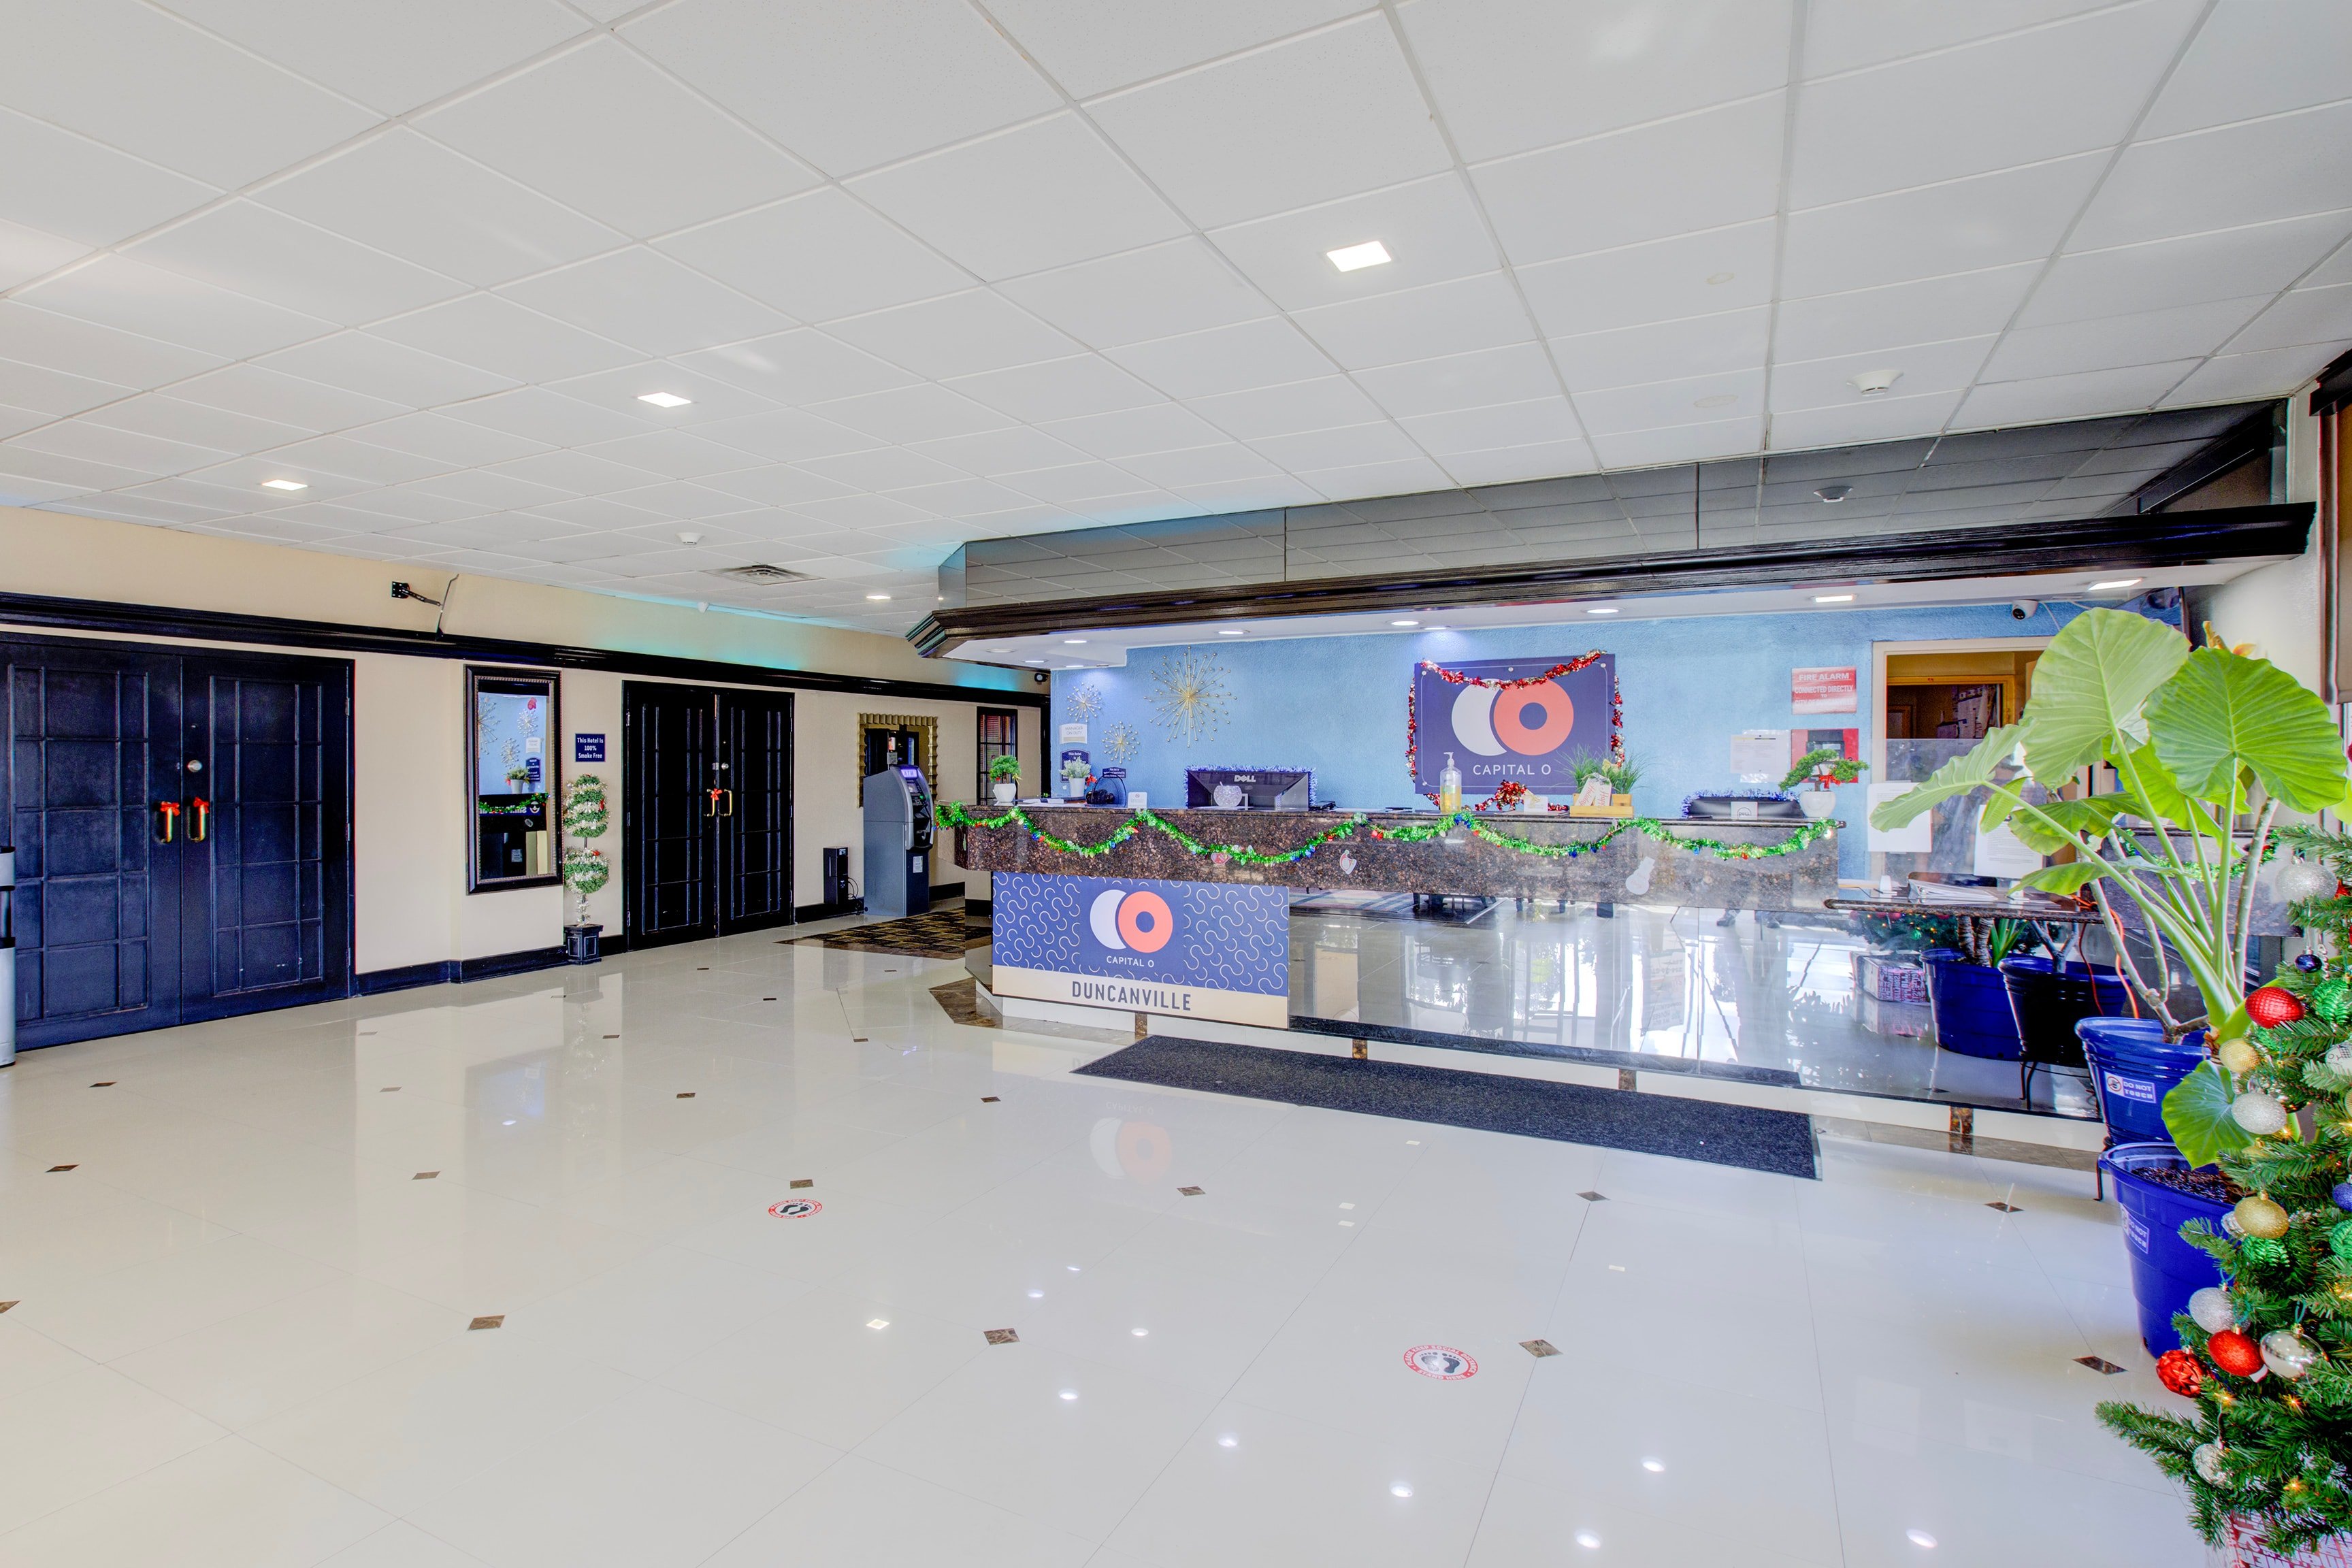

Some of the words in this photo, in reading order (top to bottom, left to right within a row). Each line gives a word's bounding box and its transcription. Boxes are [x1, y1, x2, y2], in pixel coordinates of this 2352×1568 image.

[1795, 685, 1827, 693] CONNECTED
[1827, 685, 1853, 693] DIRECTLY
[1472, 764, 1535, 775] CAPITAL
[1541, 764, 1552, 775] O
[1234, 774, 1256, 783] DELL
[1106, 956, 1145, 967] CAPITAL
[1147, 960, 1154, 968] O
[1072, 981, 1191, 1011] DUNCANVILLE
[2125, 1089, 2153, 1099] TOUCH
[2135, 1225, 2147, 1237] NOT
[1431, 1345, 1460, 1354] SOCIAL
[1417, 1369, 1445, 1379] STAND
